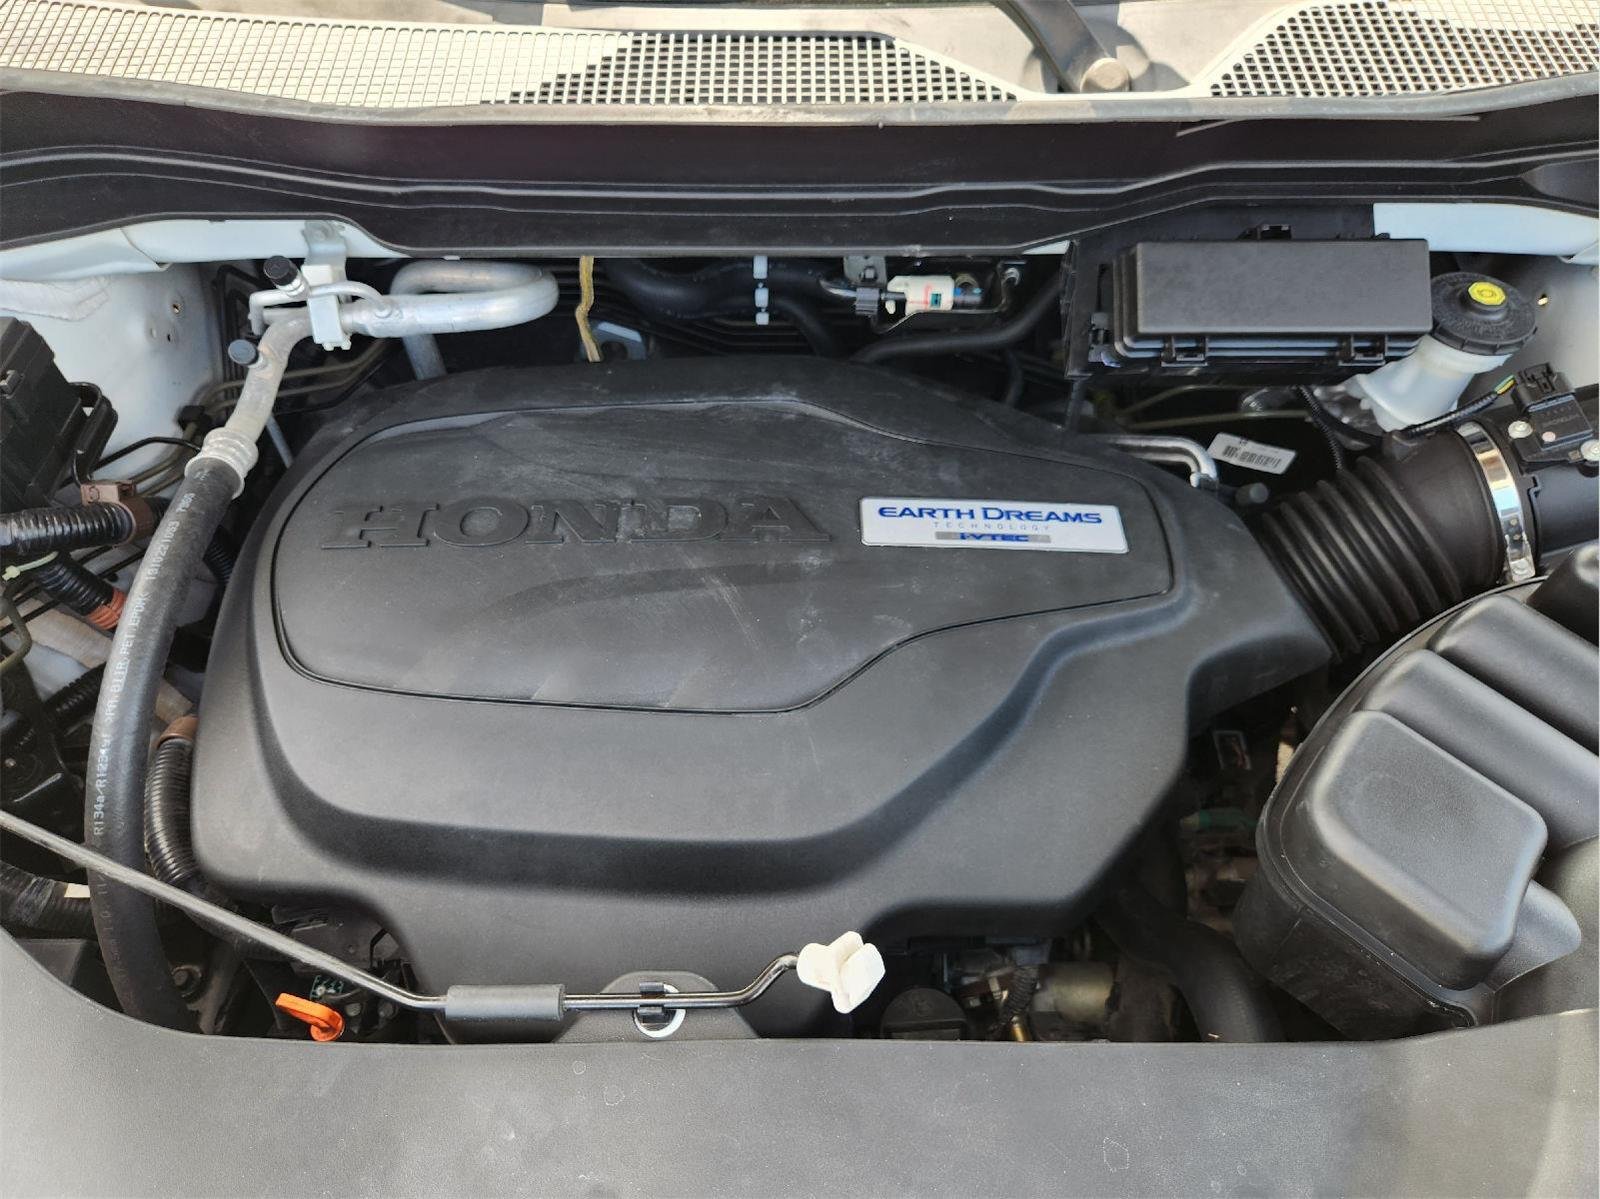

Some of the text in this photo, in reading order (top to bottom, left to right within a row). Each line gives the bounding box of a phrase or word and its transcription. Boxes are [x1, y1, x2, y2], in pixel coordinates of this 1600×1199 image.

[878, 507, 1102, 523] EARTH DREAMS
[321, 498, 833, 549] HONDA
[933, 521, 1049, 531] TECHNOLOGY
